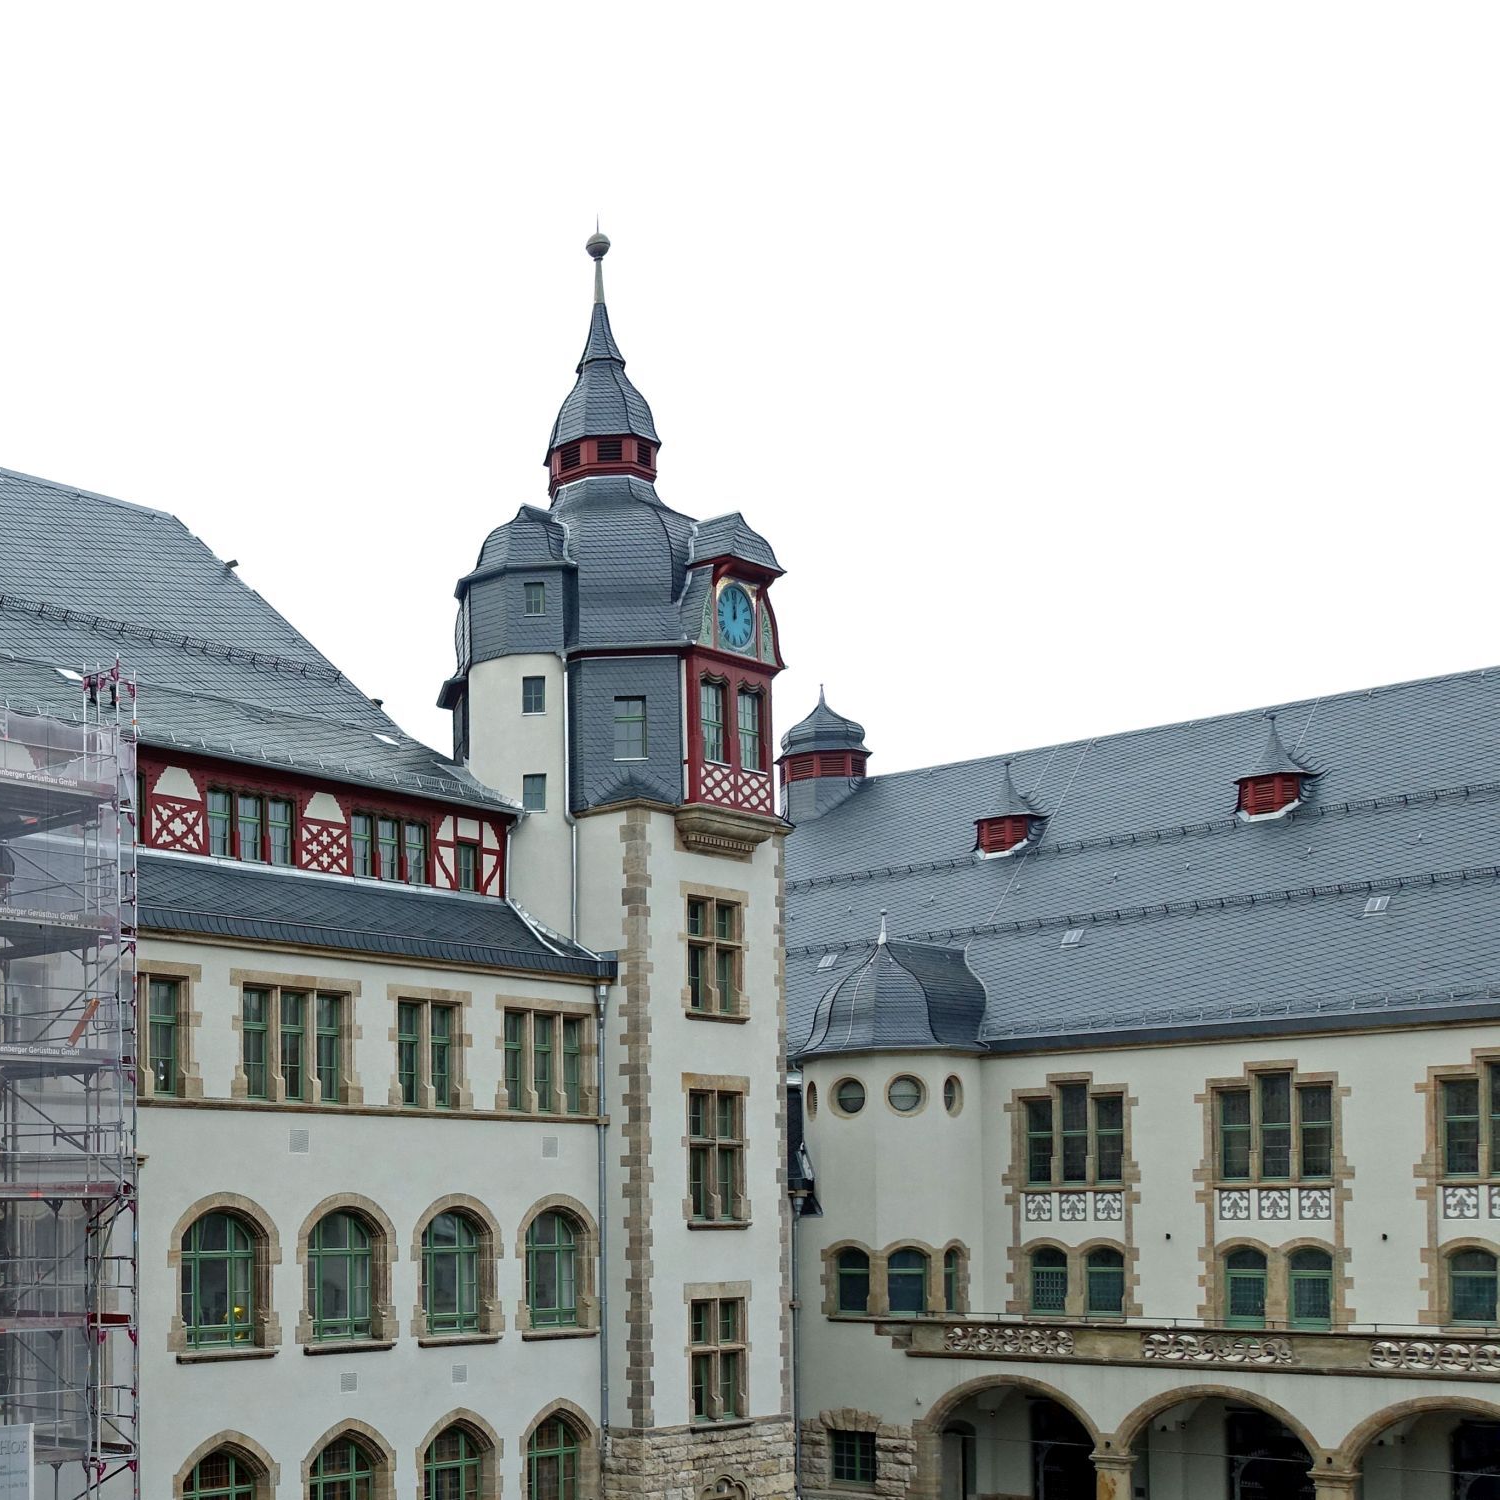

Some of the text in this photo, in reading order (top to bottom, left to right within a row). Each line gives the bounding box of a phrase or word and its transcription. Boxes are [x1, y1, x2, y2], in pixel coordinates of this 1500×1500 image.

[58, 777, 78, 787] GmbH
[60, 912, 79, 921] GmbH
[61, 1047, 80, 1056] GmbH
